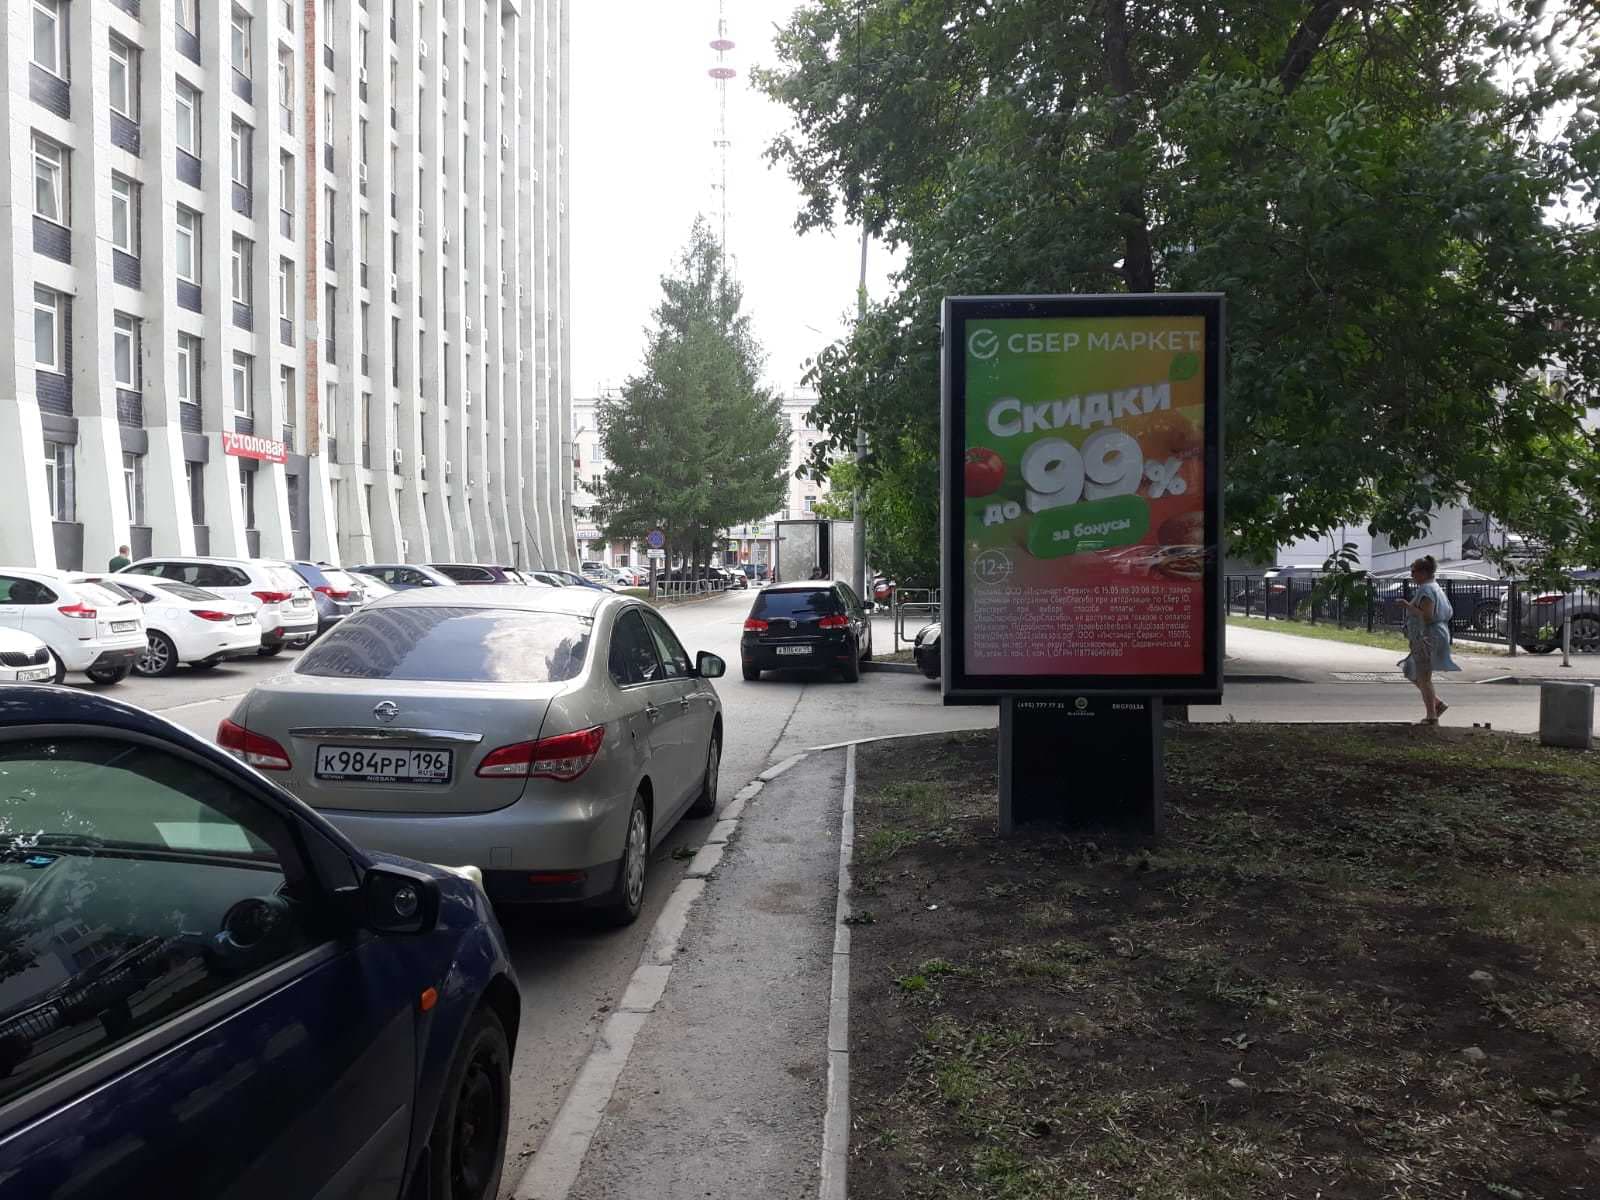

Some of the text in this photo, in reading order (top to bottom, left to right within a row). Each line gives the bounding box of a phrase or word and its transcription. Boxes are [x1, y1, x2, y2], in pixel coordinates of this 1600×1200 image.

[1007, 330, 1200, 353] СБЕР МАРКЕТ
[988, 383, 1170, 437] Скидки
[983, 501, 1022, 527] до
[1052, 518, 1131, 542] за бонусы
[980, 559, 1005, 576] 12+
[412, 753, 444, 770] 196
